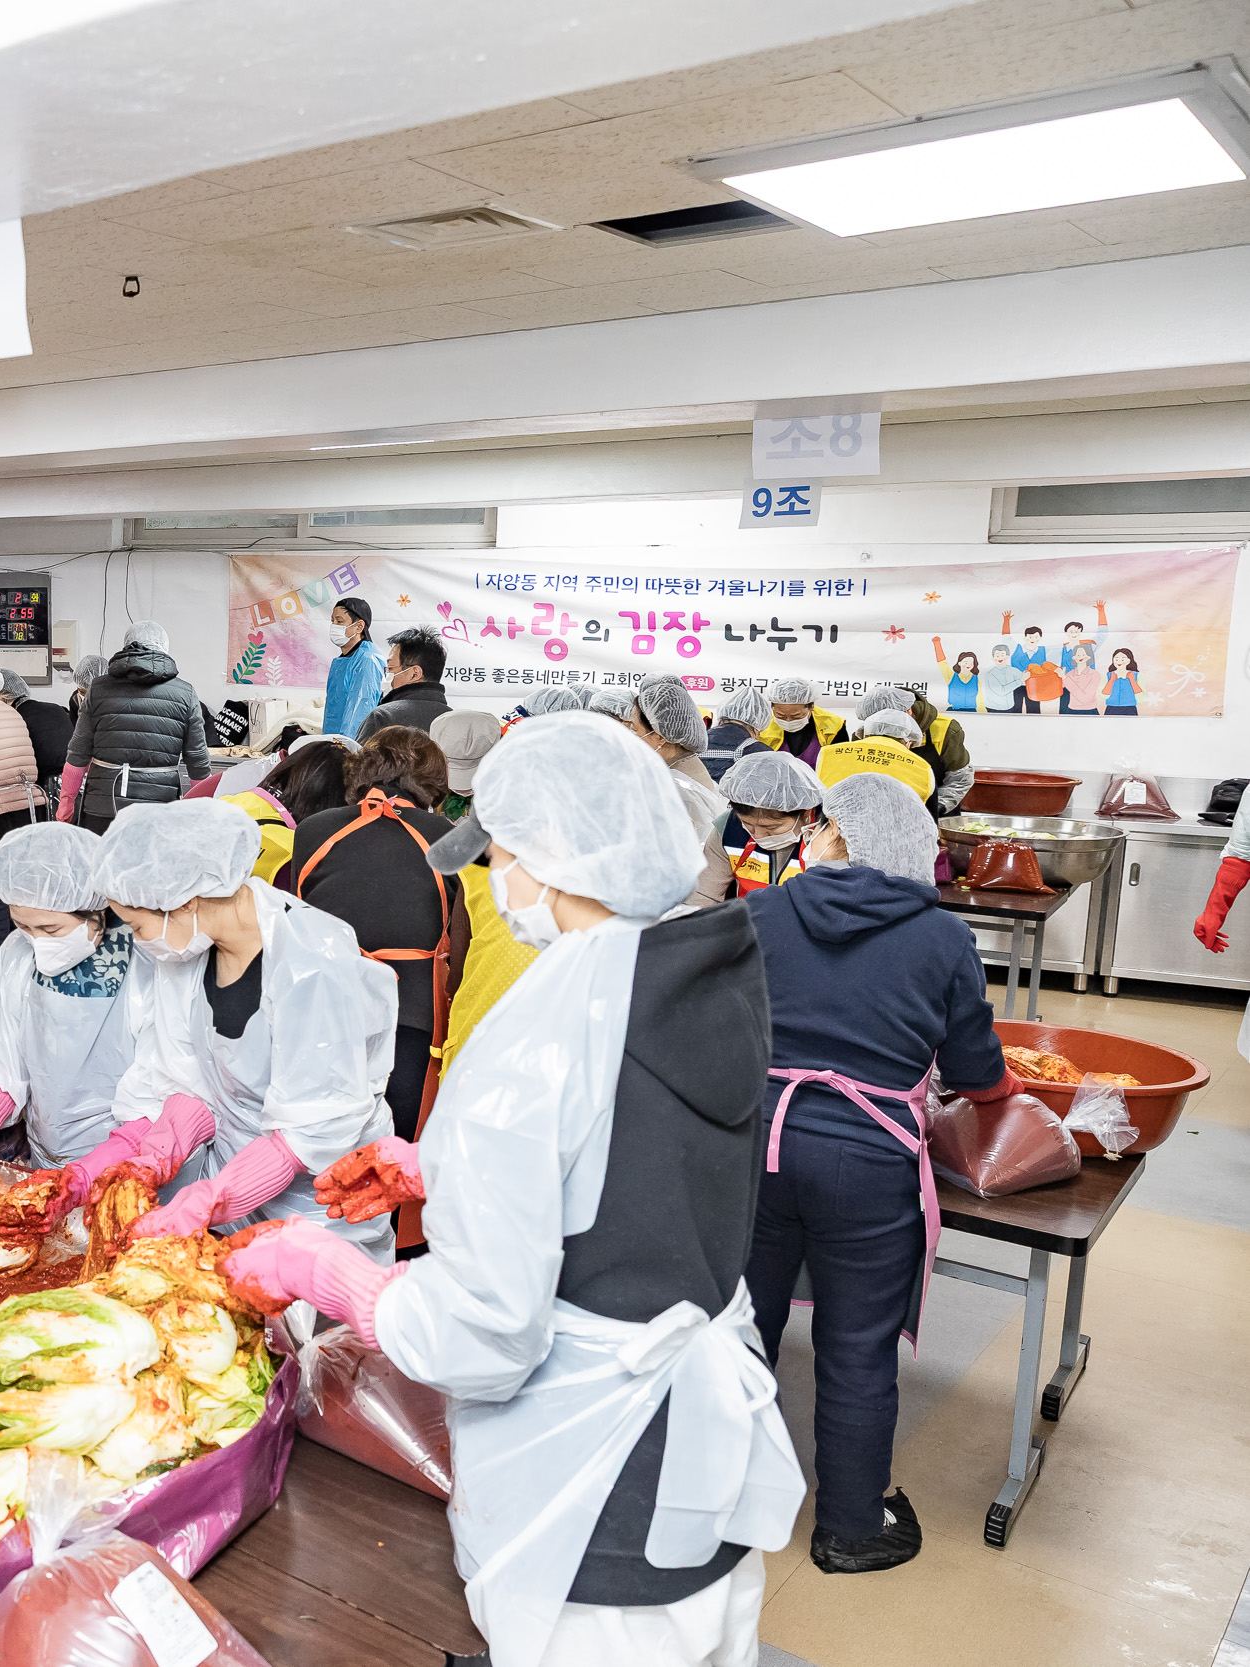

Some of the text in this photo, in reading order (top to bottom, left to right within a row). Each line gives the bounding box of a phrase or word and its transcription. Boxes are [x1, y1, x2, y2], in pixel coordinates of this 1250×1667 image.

[751, 485, 811, 518] 9조
[485, 573, 855, 597] 자양동 지역 주민의 따뜻한 겨울나기를 위한
[14, 592, 22, 604] 2
[253, 565, 355, 625] LOVE
[479, 602, 839, 662] 사랑의 김장 나누기
[444, 666, 487, 683] 자양동
[491, 667, 596, 685] 좋은동네만들기
[685, 677, 710, 690] 후원
[811, 679, 867, 697] 단법인
[222, 717, 243, 733] MAKE
